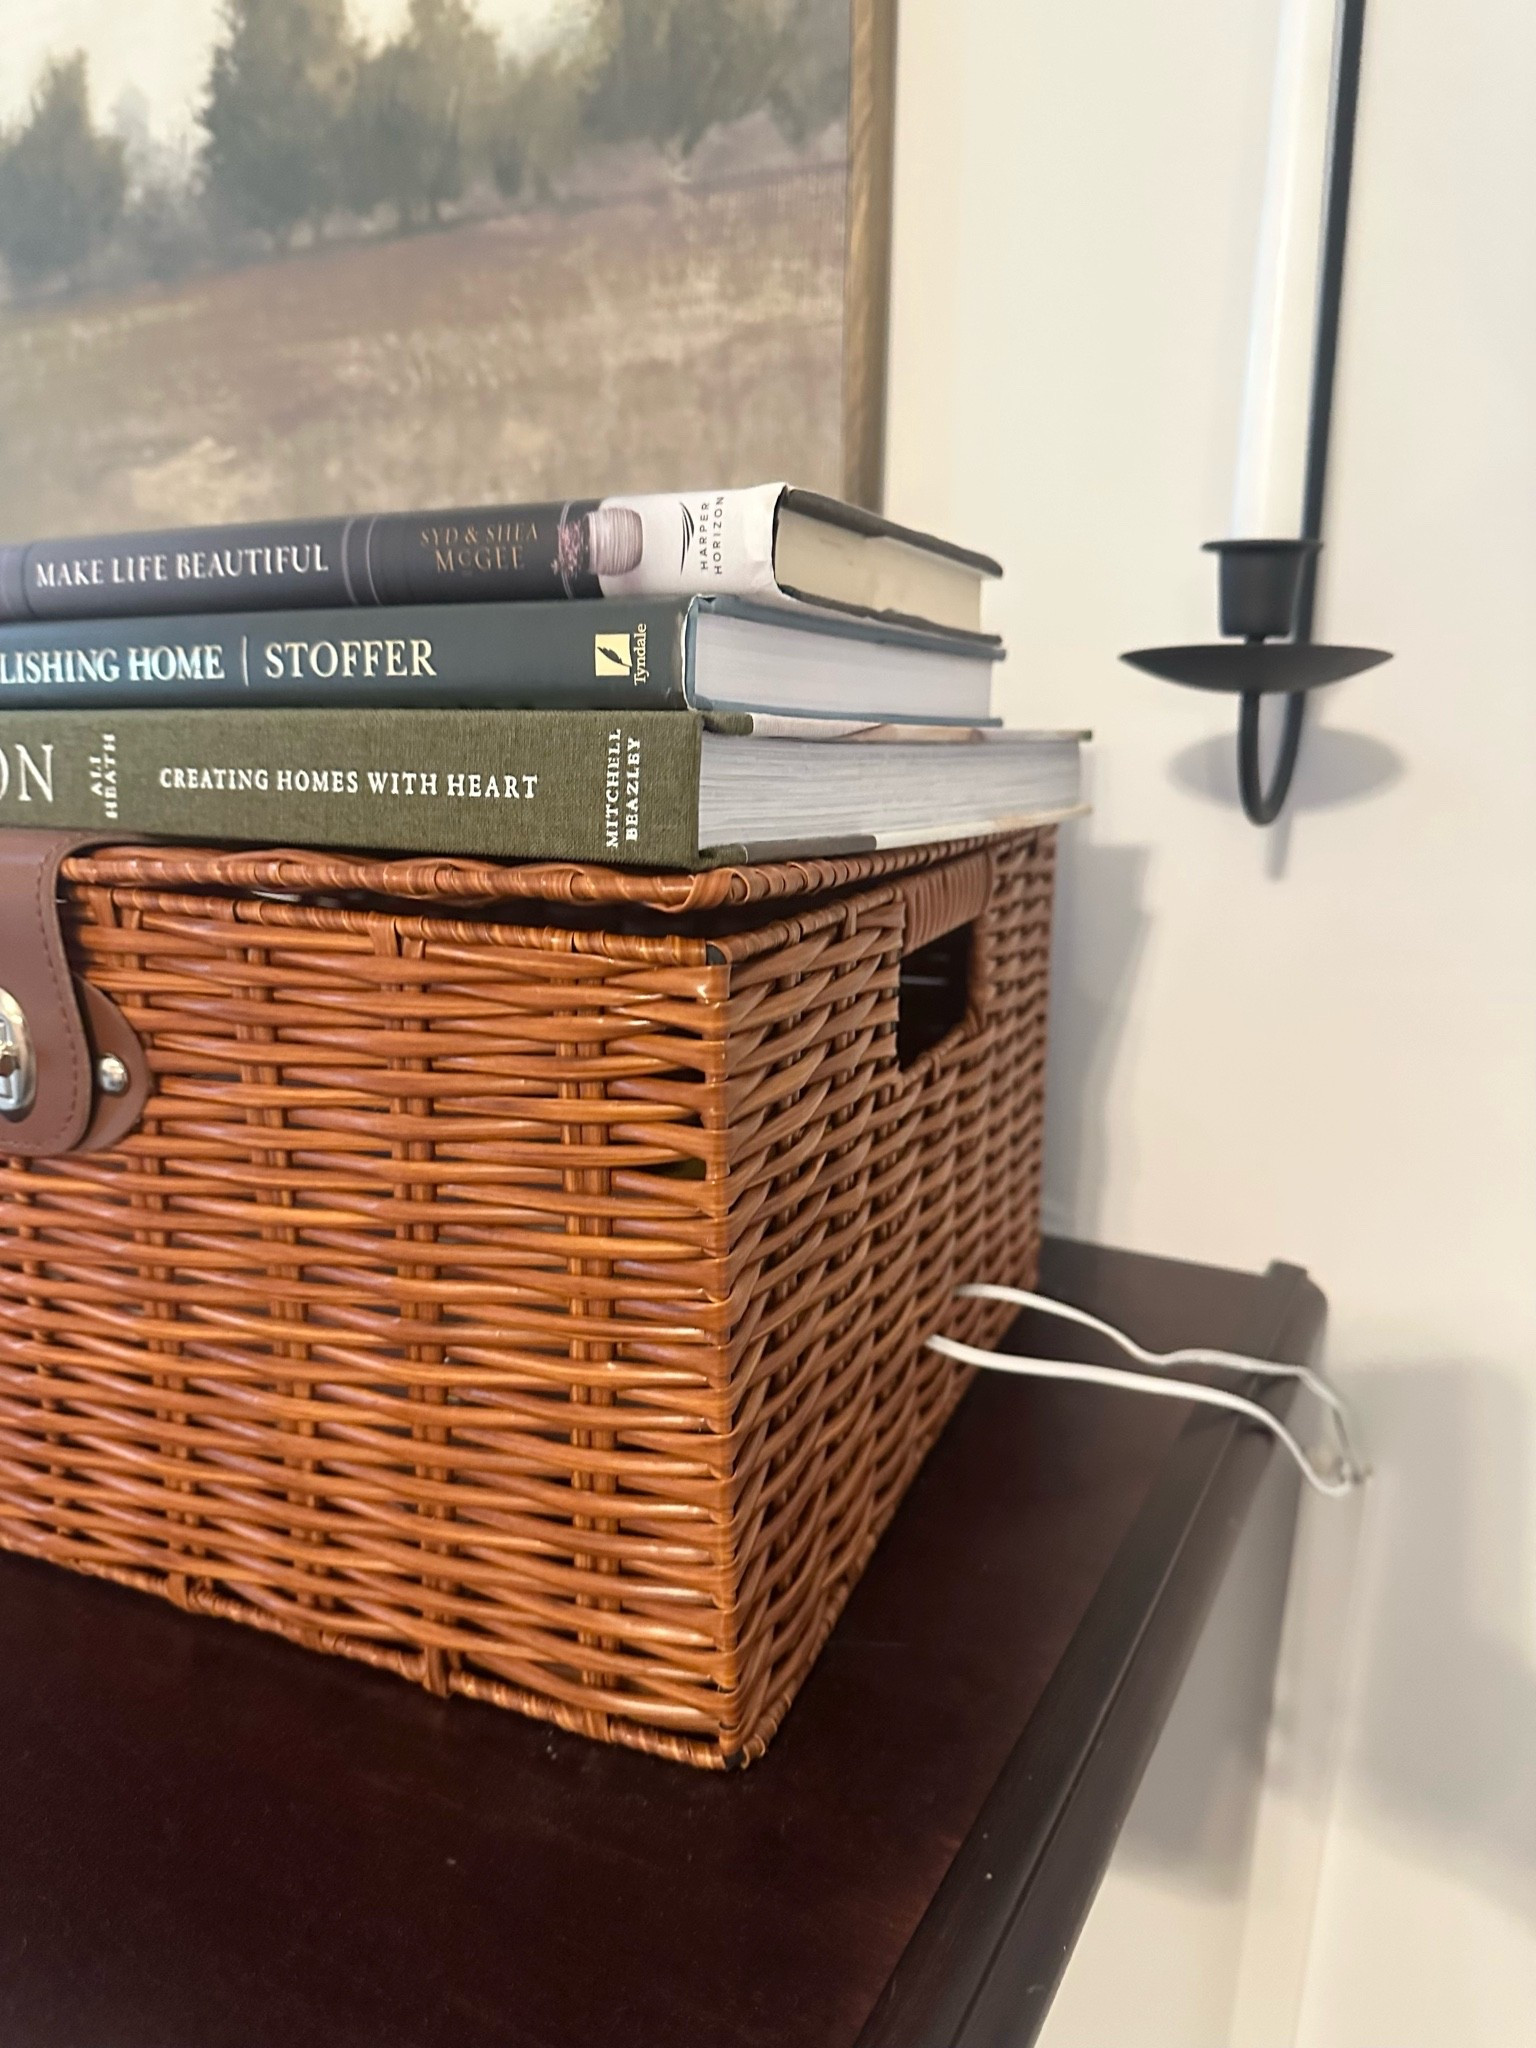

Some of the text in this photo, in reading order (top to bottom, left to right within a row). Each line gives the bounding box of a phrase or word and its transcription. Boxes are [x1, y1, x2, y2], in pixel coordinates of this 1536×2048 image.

[420, 522, 537, 548] SYD & SHEA
[699, 502, 710, 571] HARPER
[714, 496, 724, 576] HORIZON
[37, 543, 329, 588] MAKE LIFE BEAUTIFUL
[0, 645, 226, 685] LISHING HOME
[263, 639, 437, 679] STOFFER
[633, 623, 649, 686] Tyndale
[0, 744, 53, 802] N
[89, 756, 103, 796] ALI
[102, 733, 119, 820] HEATH
[159, 767, 539, 799] CREATING HOMES WITH HEART
[605, 728, 622, 848] MITCHELL
[625, 736, 641, 842] BEAZLEY
